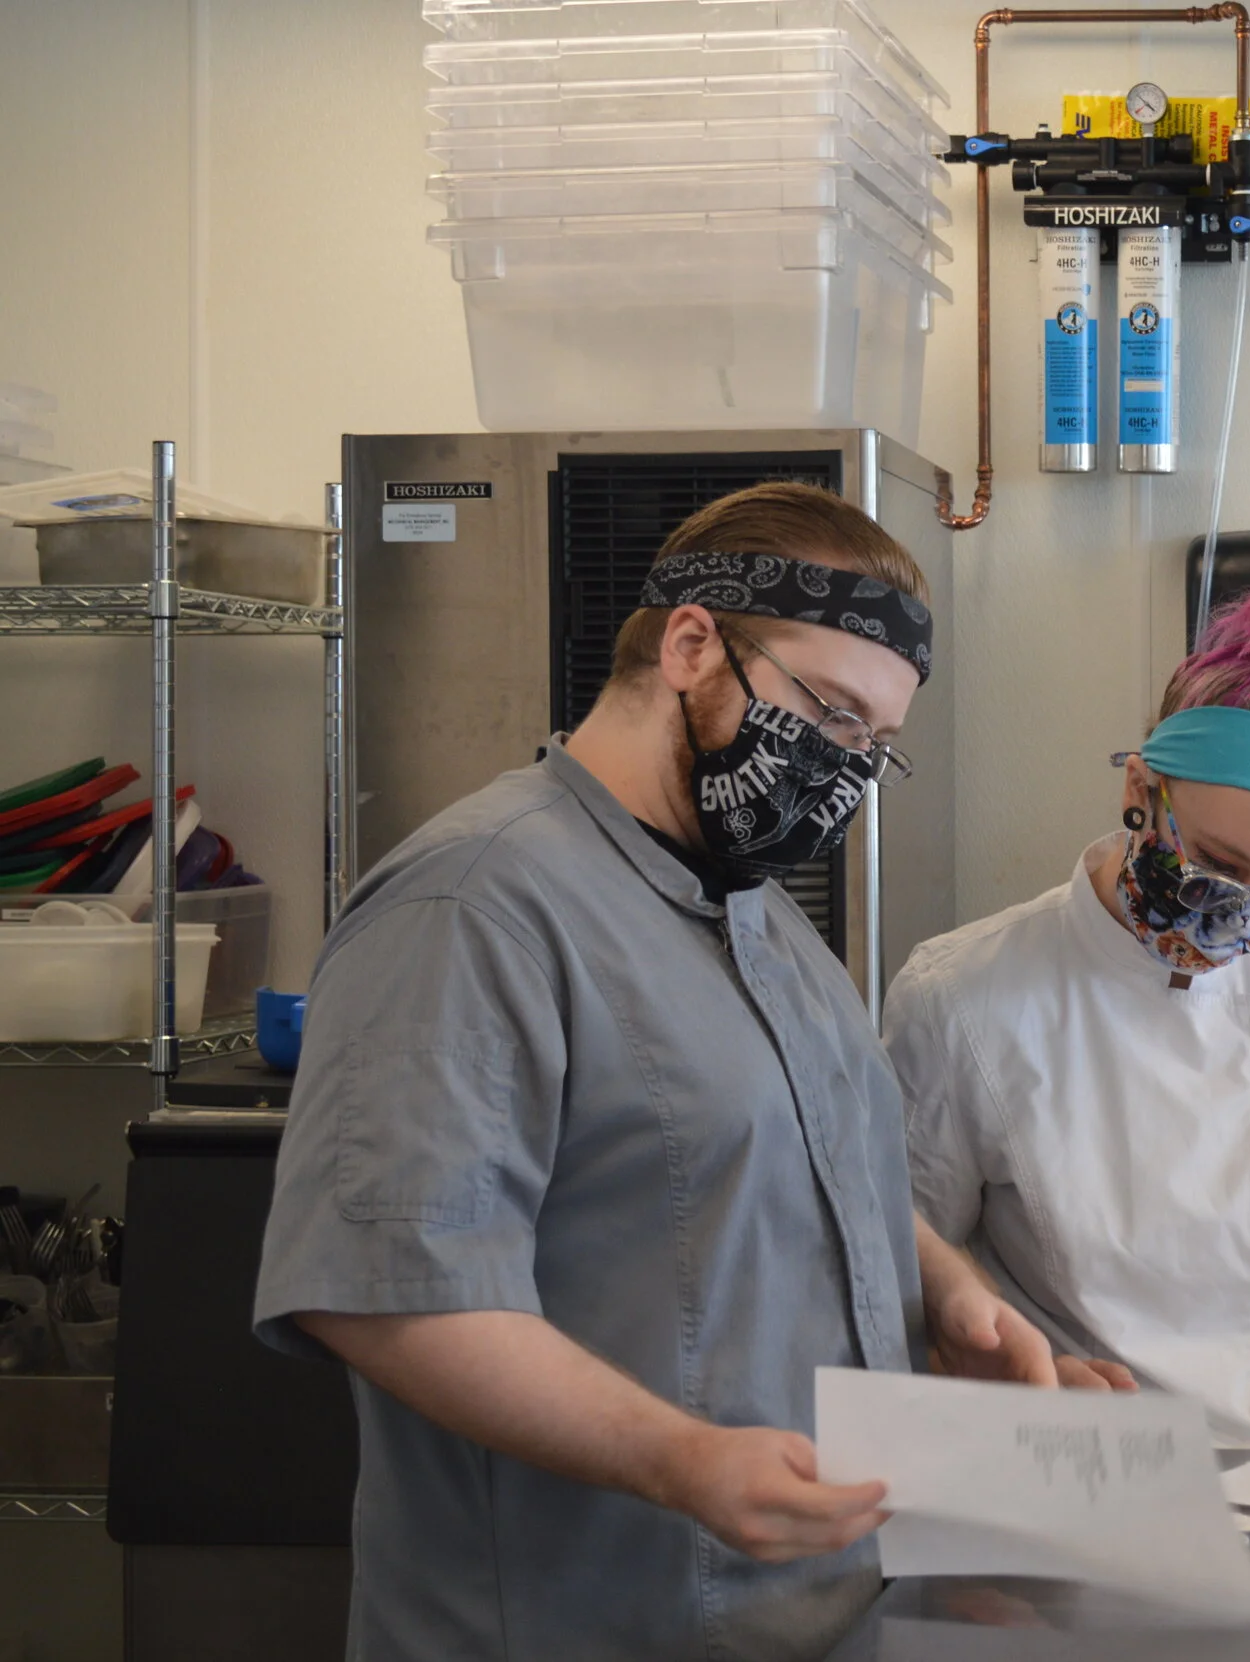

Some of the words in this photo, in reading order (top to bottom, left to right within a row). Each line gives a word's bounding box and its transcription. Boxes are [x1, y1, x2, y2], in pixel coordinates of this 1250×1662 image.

[1209, 112, 1218, 149] METAL
[1054, 206, 1160, 225] HOSHIZAKI
[1129, 256, 1160, 267] 4HC-H
[1128, 417, 1158, 428] 4HC-H
[393, 484, 487, 497] HOSHIZAKI
